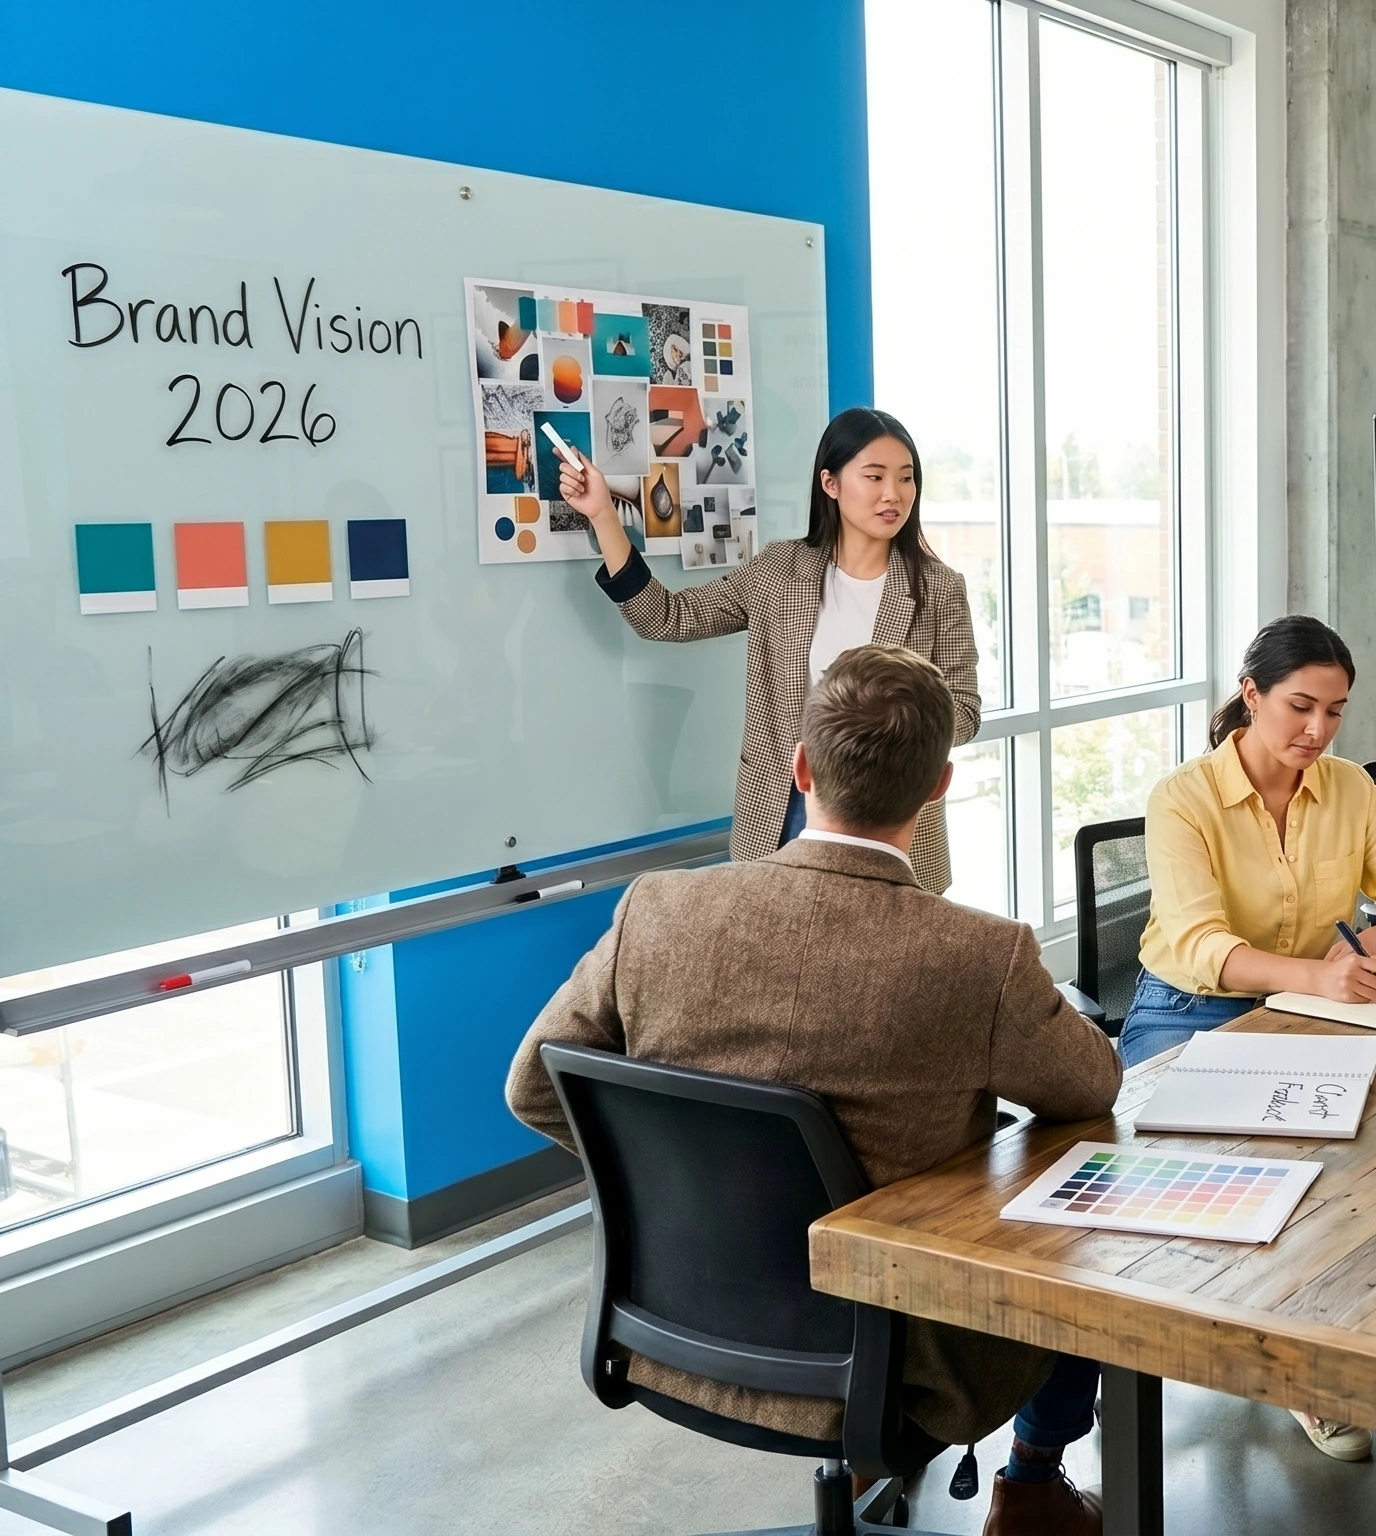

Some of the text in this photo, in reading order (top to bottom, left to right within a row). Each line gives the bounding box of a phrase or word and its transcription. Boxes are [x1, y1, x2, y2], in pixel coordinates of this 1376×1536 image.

[61, 262, 423, 360] Brand Vision
[165, 374, 337, 448] 2026
